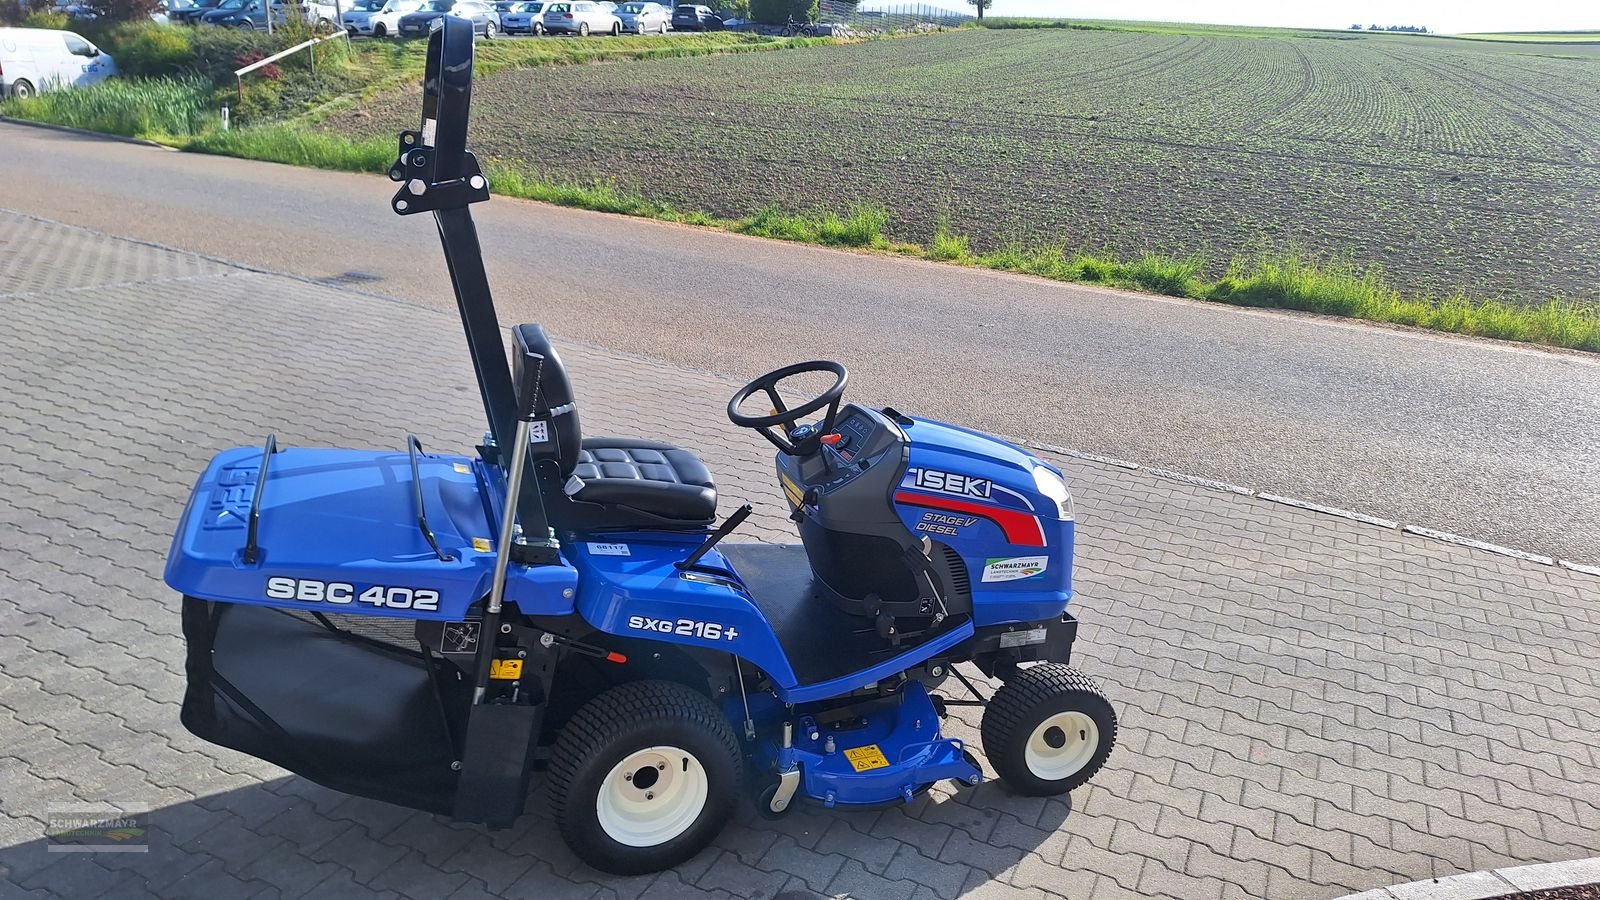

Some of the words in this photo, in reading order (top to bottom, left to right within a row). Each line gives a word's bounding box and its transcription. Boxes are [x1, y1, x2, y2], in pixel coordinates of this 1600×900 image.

[916, 468, 991, 498] ISEKI
[923, 513, 964, 526] STAGE
[964, 517, 978, 527] V
[915, 522, 958, 536] DIESEL
[990, 561, 1039, 570] SCHWARZMAYR
[266, 576, 354, 605] SBC
[358, 585, 440, 612] 402
[628, 616, 673, 633] SXG
